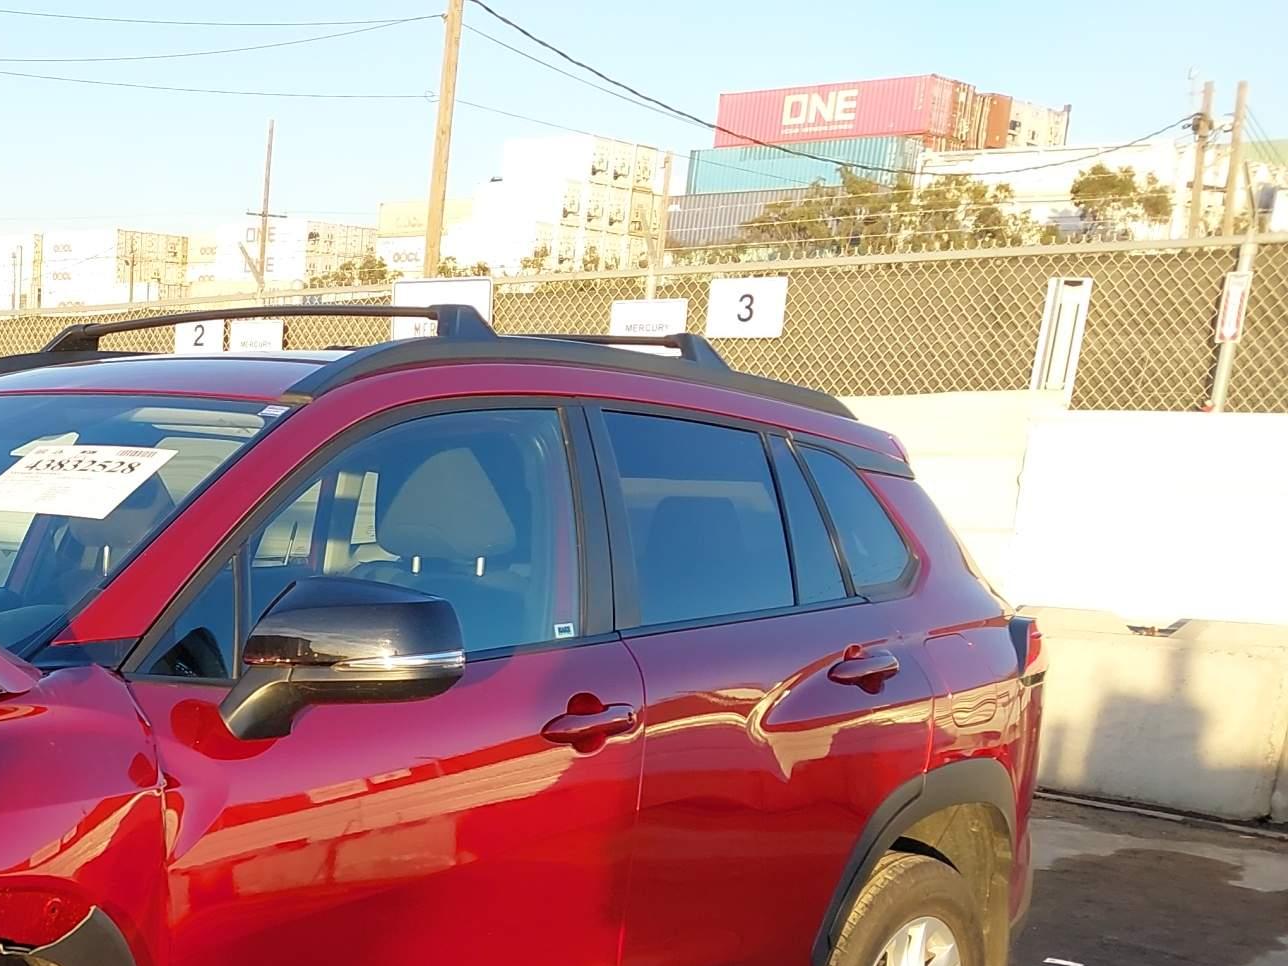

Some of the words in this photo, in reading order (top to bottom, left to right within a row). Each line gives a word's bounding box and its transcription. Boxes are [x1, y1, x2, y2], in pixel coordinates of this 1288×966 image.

[782, 89, 859, 126] ONE
[736, 293, 755, 323] 3
[192, 324, 205, 347] 2
[24, 459, 142, 475] 43832528
